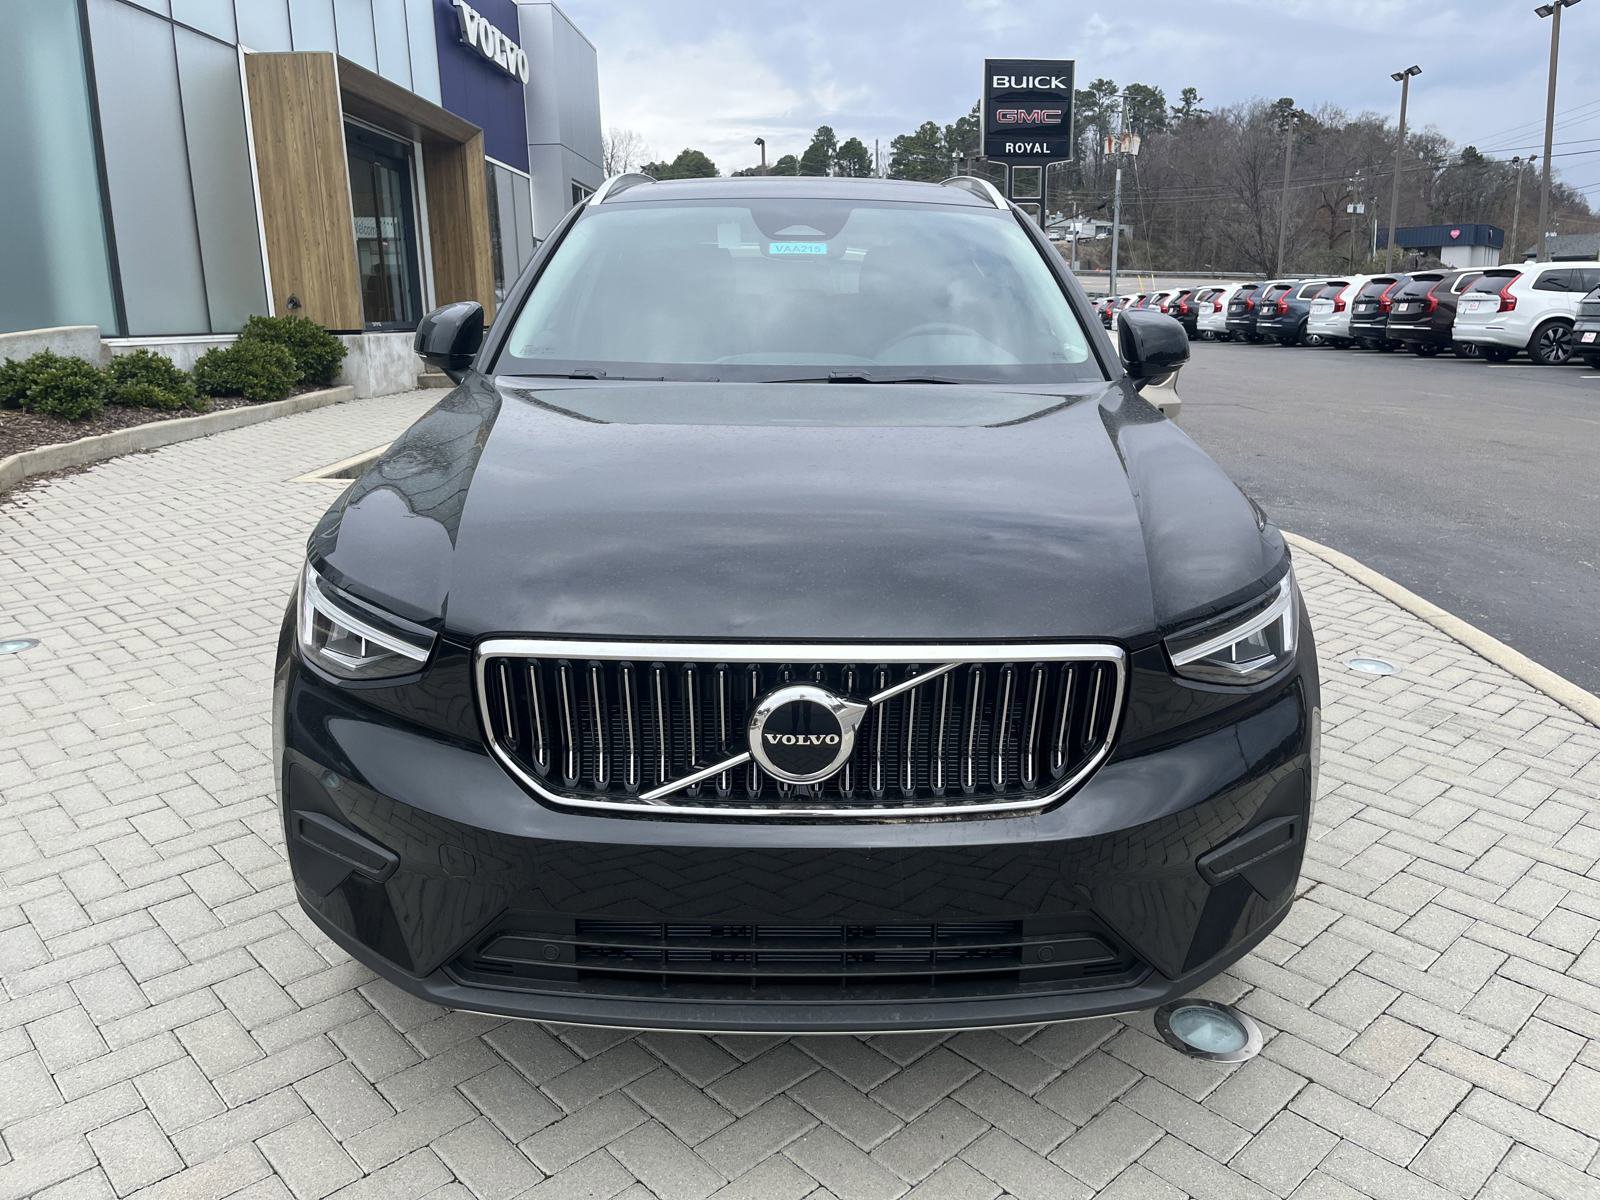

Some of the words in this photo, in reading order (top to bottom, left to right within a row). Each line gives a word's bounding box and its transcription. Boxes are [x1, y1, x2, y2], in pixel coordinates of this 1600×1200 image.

[452, 0, 530, 85] VOLVO
[992, 75, 1068, 89] BUICK
[996, 109, 1062, 124] GMC
[1005, 142, 1051, 154] ROYAL
[764, 733, 840, 745] VOLVO
